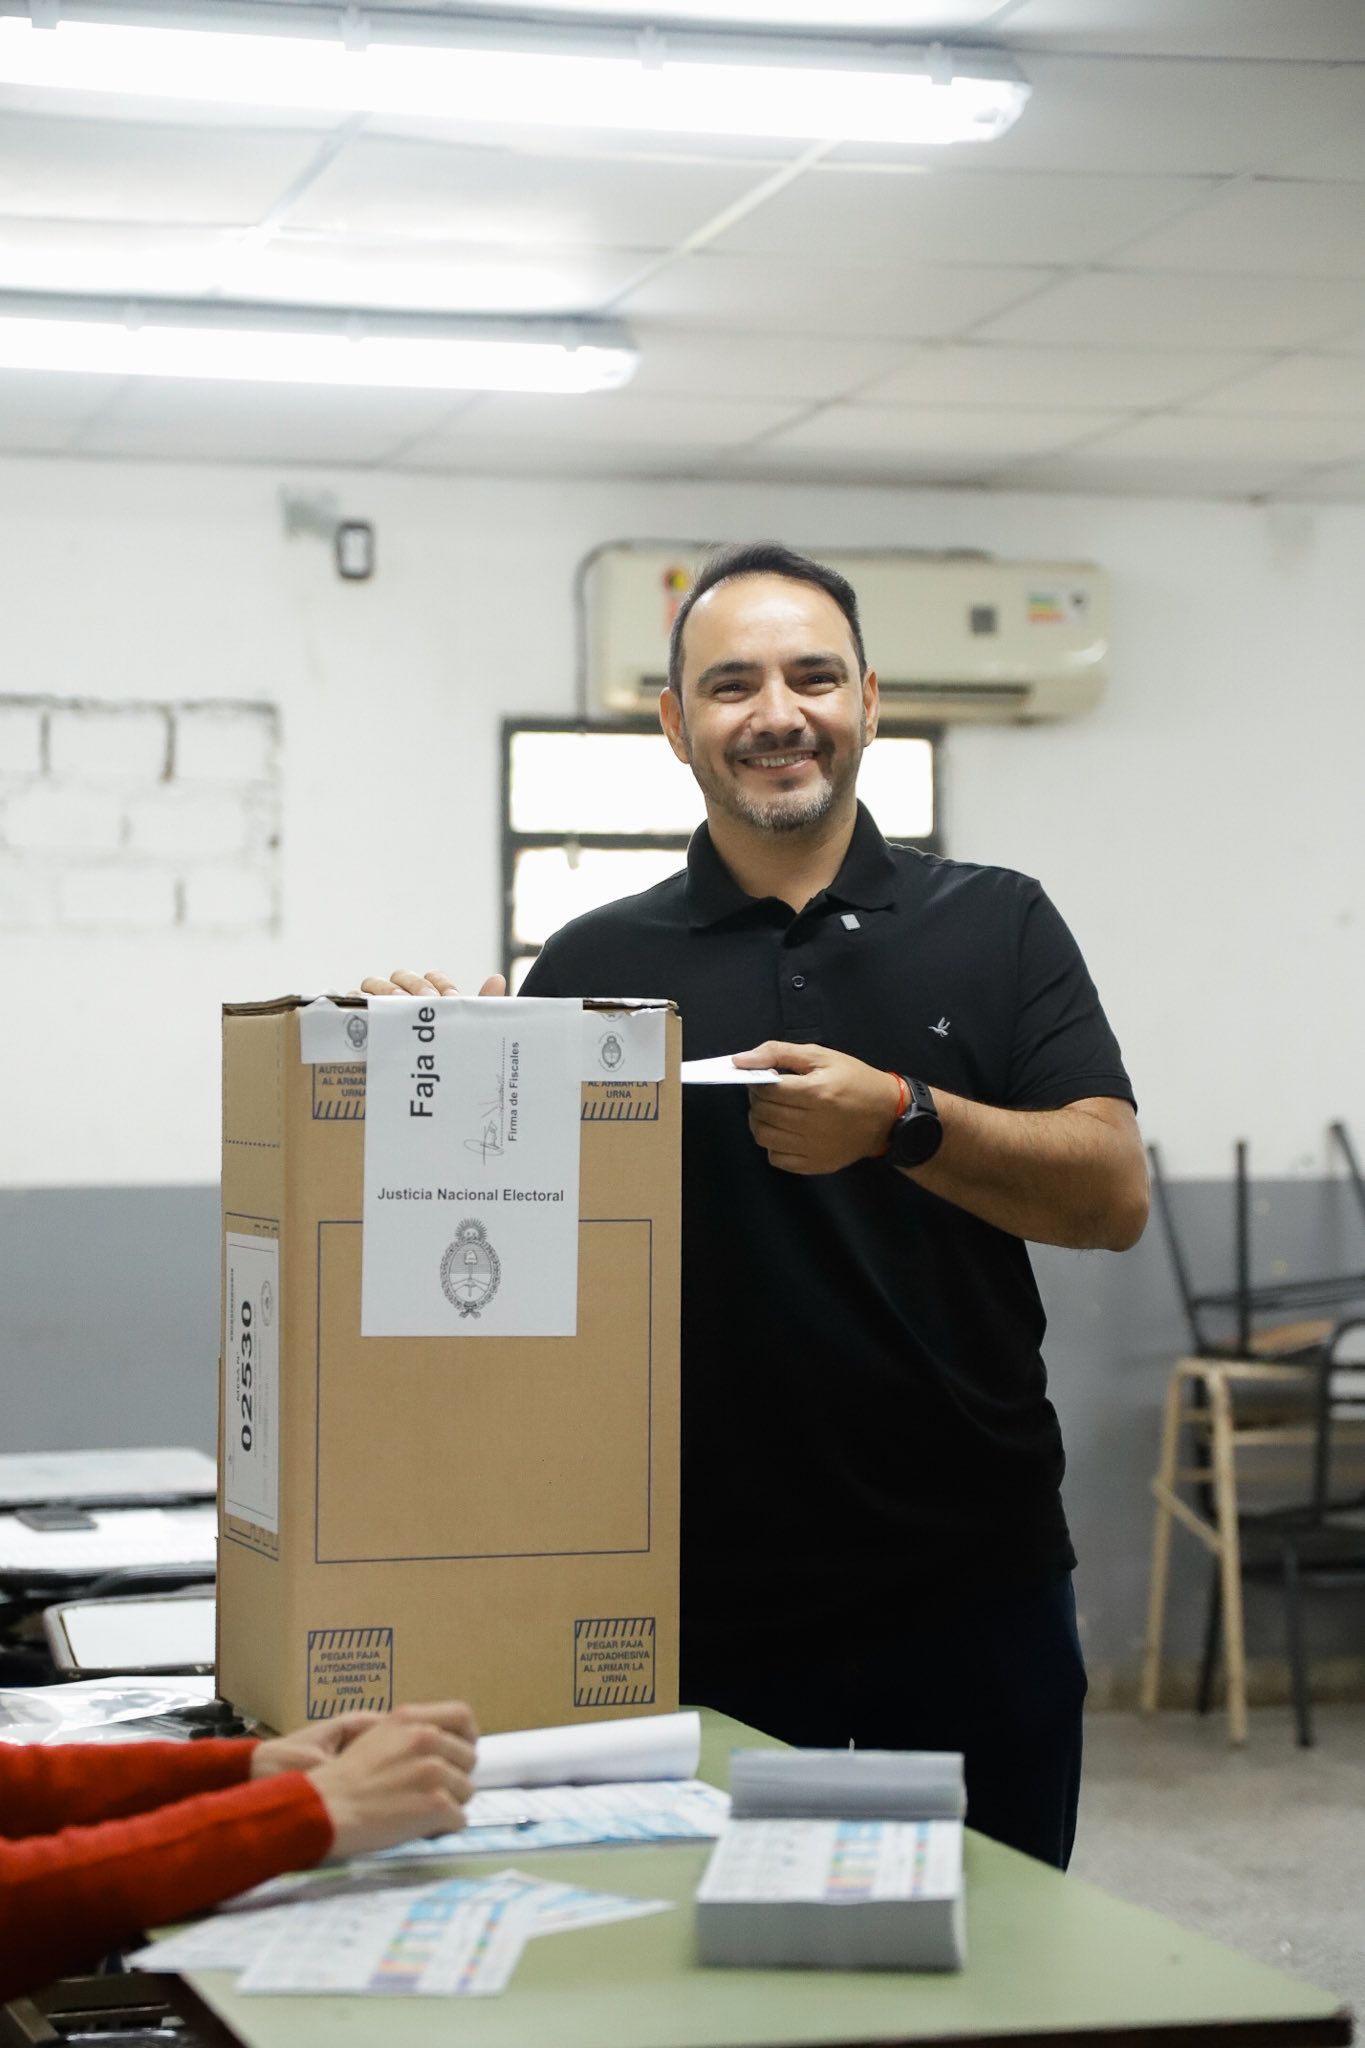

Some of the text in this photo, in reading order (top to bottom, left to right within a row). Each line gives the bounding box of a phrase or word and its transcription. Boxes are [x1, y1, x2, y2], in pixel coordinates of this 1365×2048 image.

[410, 1006, 440, 1117] Faja de
[322, 1077, 367, 1085] AL ARMA
[507, 1041, 519, 1142] Firma de Fiscales
[606, 1090, 632, 1099] URNA
[377, 1187, 564, 1202] Justicia Nacional Electoral
[240, 1300, 252, 1452] 02530
[586, 1640, 643, 1650] PEGAR FAJA
[321, 1650, 380, 1661] PEGAR FAJA
[580, 1650, 650, 1662] AUTOADHESIVA
[314, 1661, 387, 1673] AUTOADHESIVA
[583, 1662, 644, 1673] AL ARMAR LA
[317, 1674, 381, 1685] AL ARMAR LA
[602, 1674, 628, 1683] URNA
[336, 1686, 364, 1696] URNA
